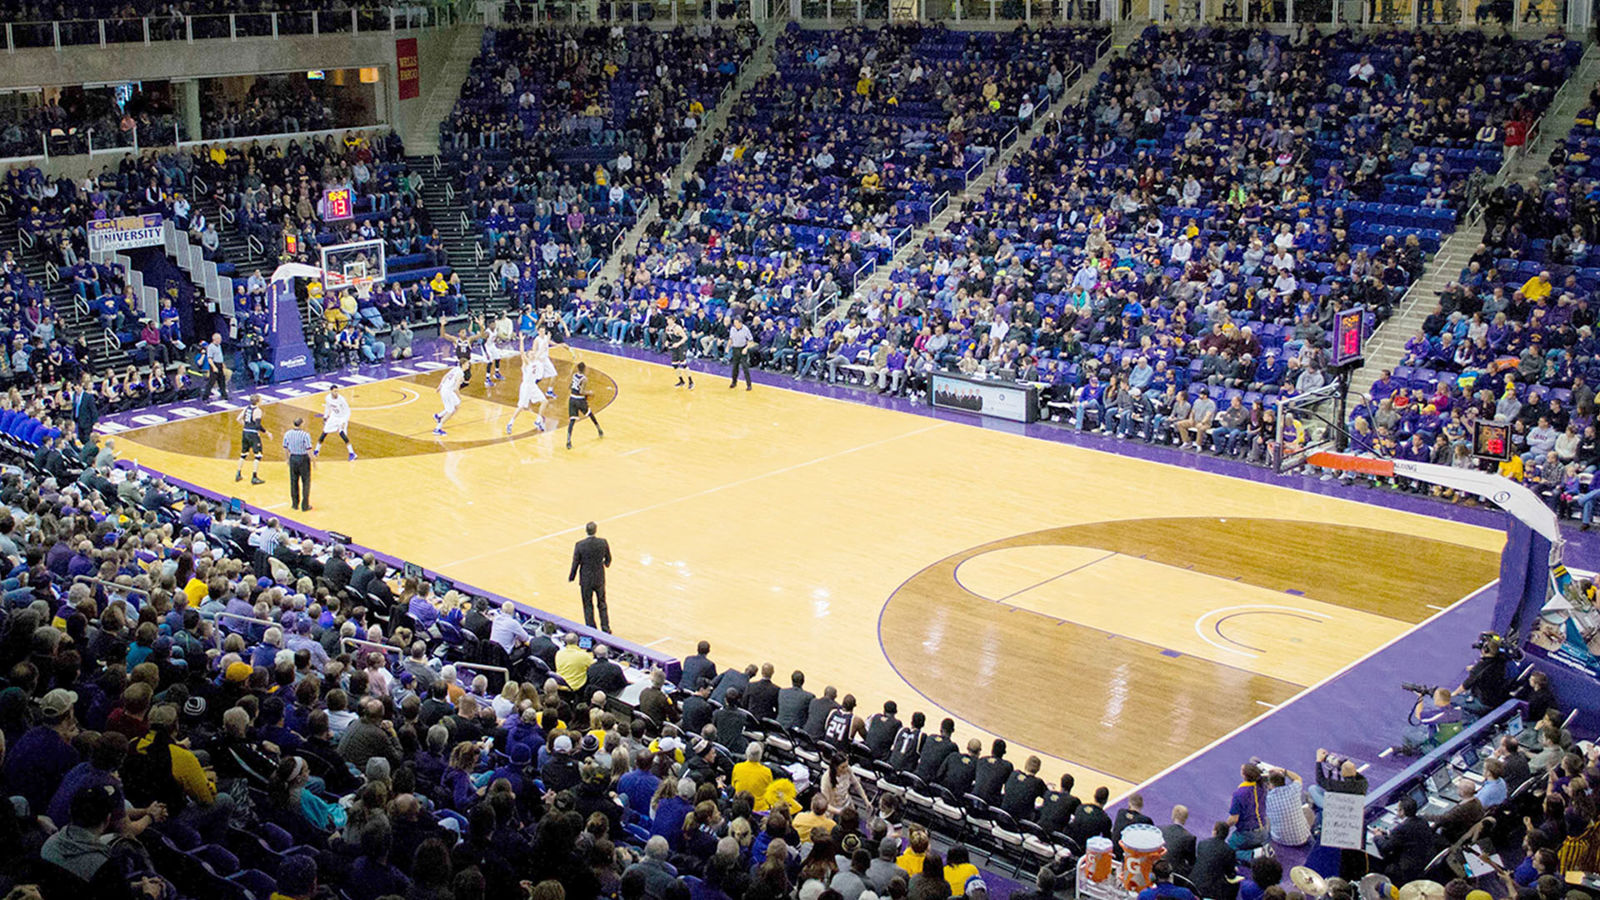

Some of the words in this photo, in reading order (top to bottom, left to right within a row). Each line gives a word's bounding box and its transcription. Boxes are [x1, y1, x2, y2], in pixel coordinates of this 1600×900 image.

[334, 200, 347, 216] 13
[91, 228, 161, 251] UNIVERSITY
[826, 721, 847, 741] 24
[1126, 856, 1141, 875] G
